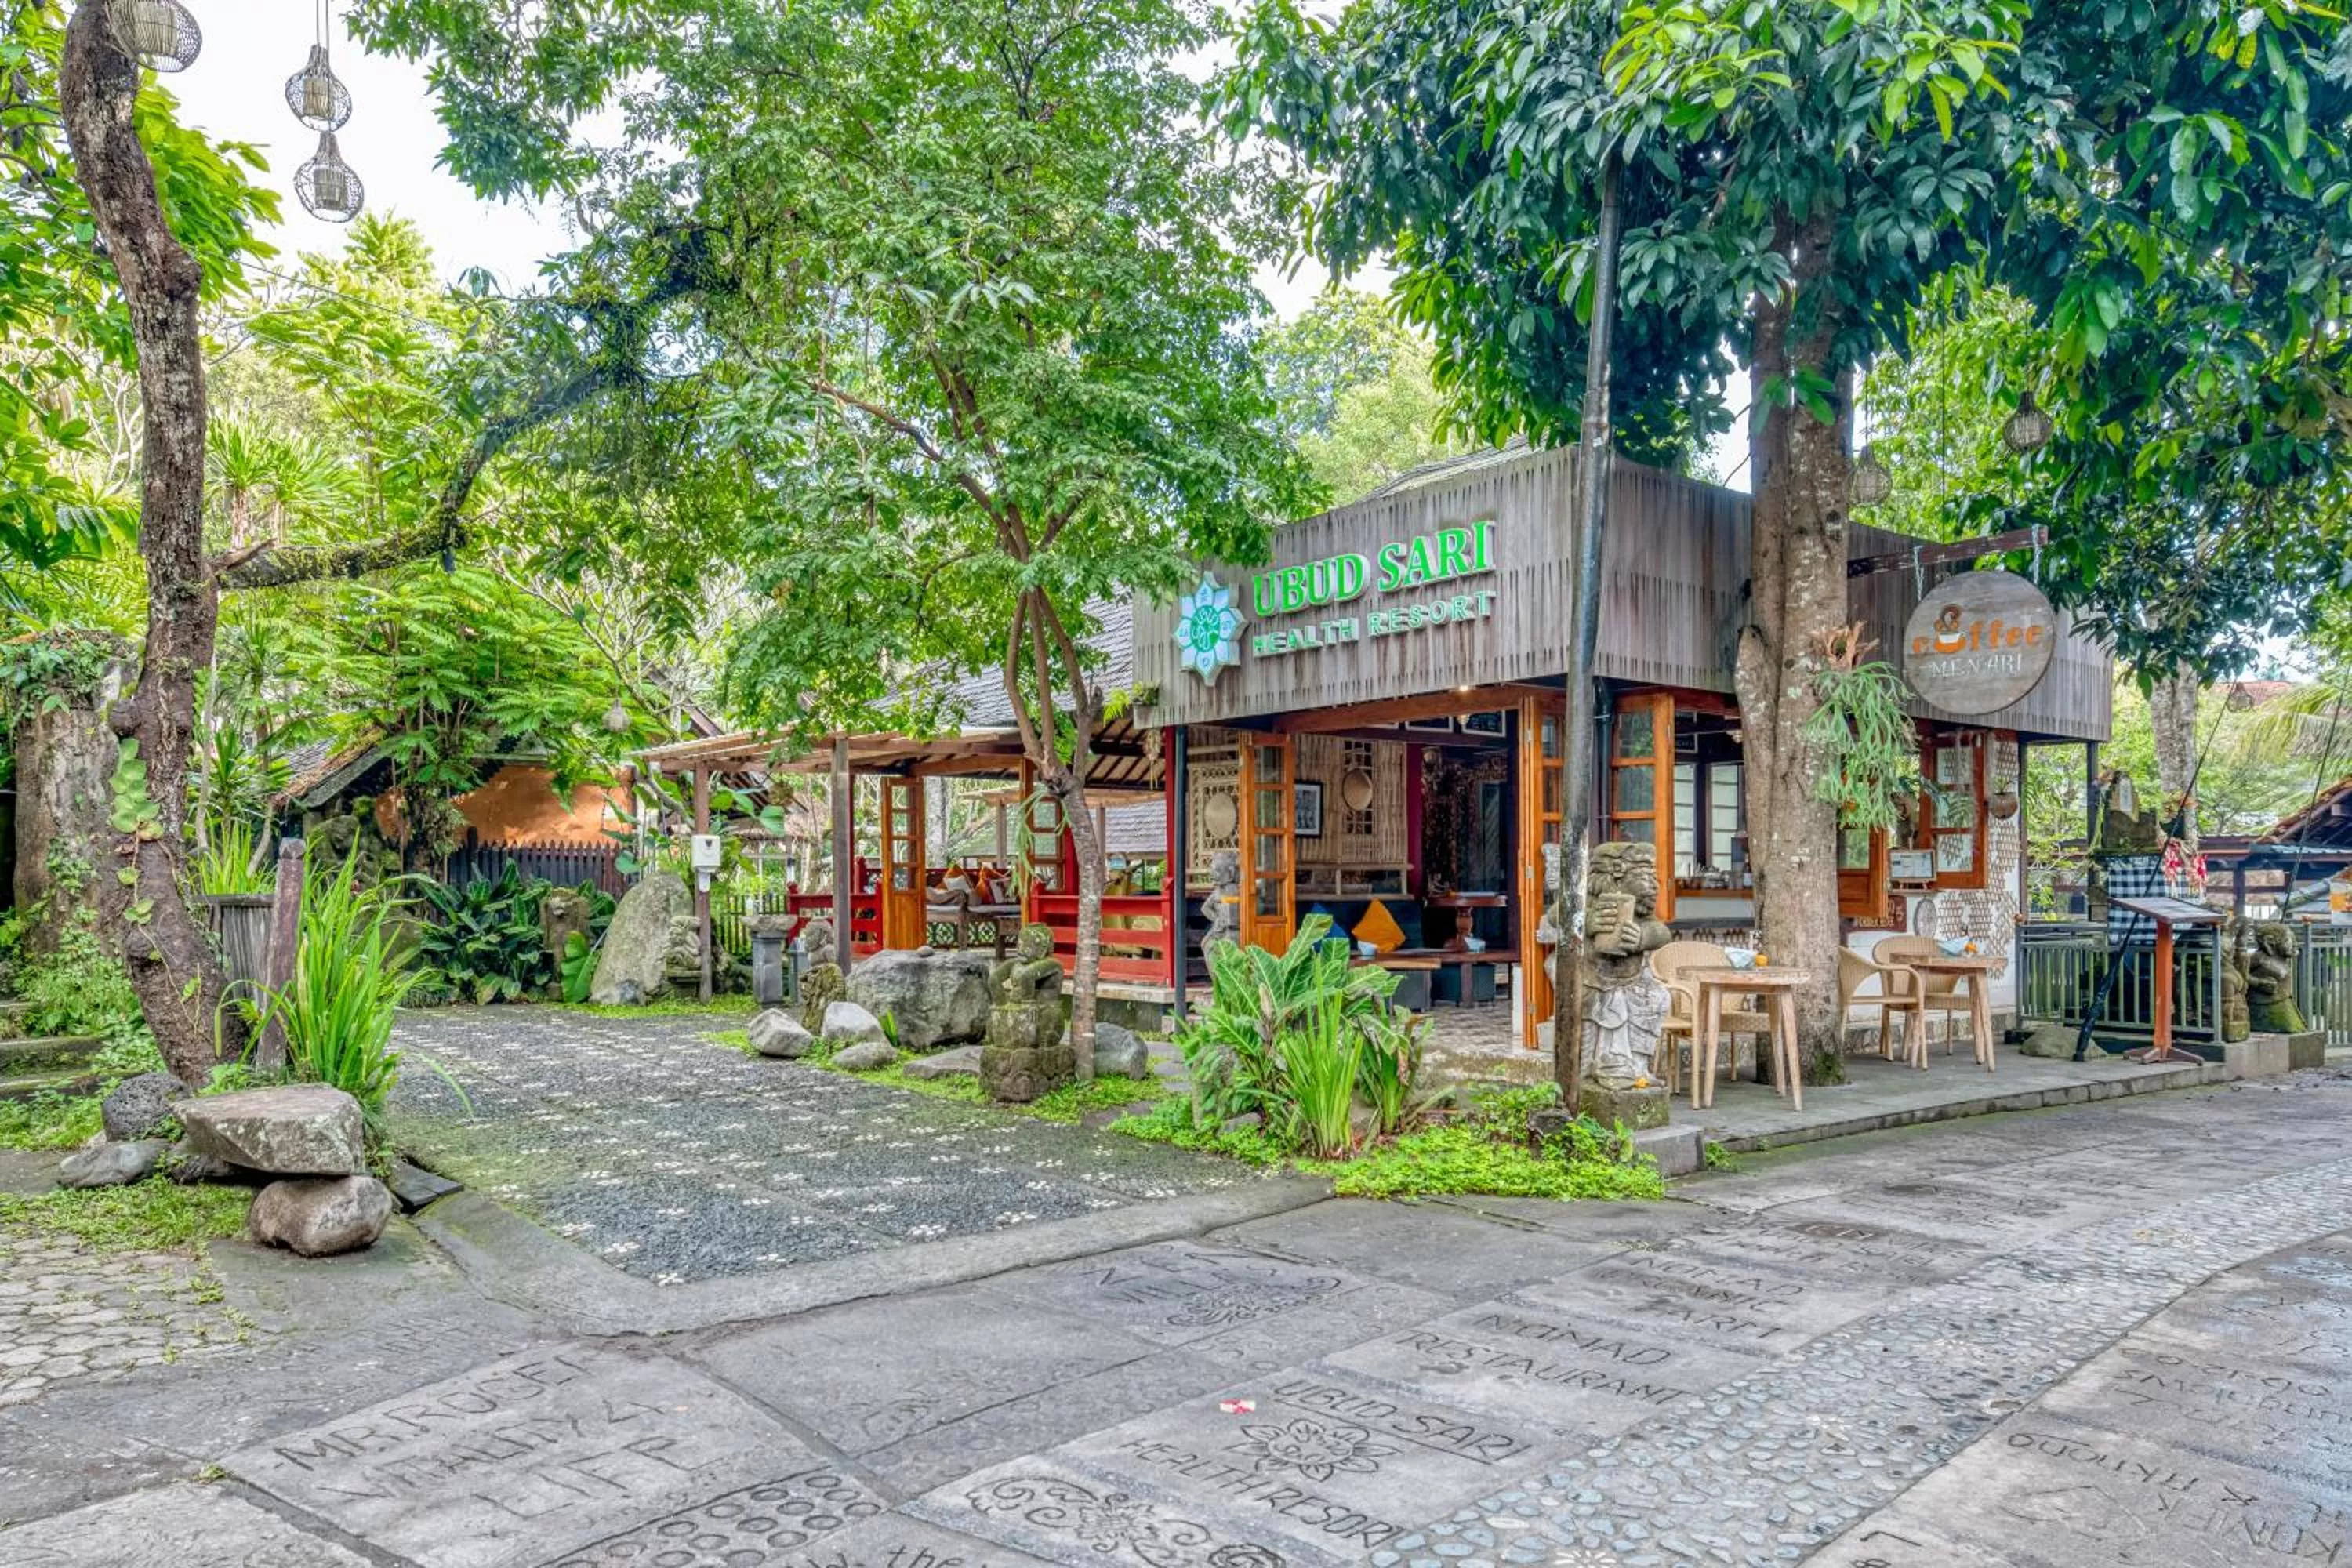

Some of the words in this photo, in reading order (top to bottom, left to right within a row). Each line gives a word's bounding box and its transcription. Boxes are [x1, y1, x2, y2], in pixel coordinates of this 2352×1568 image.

[1254, 553, 1367, 617] UBUD
[1377, 521, 1494, 593] SARI
[1254, 616, 1359, 657] HEALTH
[1367, 590, 1496, 637] RESORT
[1394, 1331, 1697, 1406] RESTAURANT
[1273, 1379, 1399, 1419] UBUD
[1393, 1414, 1532, 1465] SARI
[1118, 1437, 1269, 1494] HEALTH
[1255, 1487, 1404, 1548] RESORT
